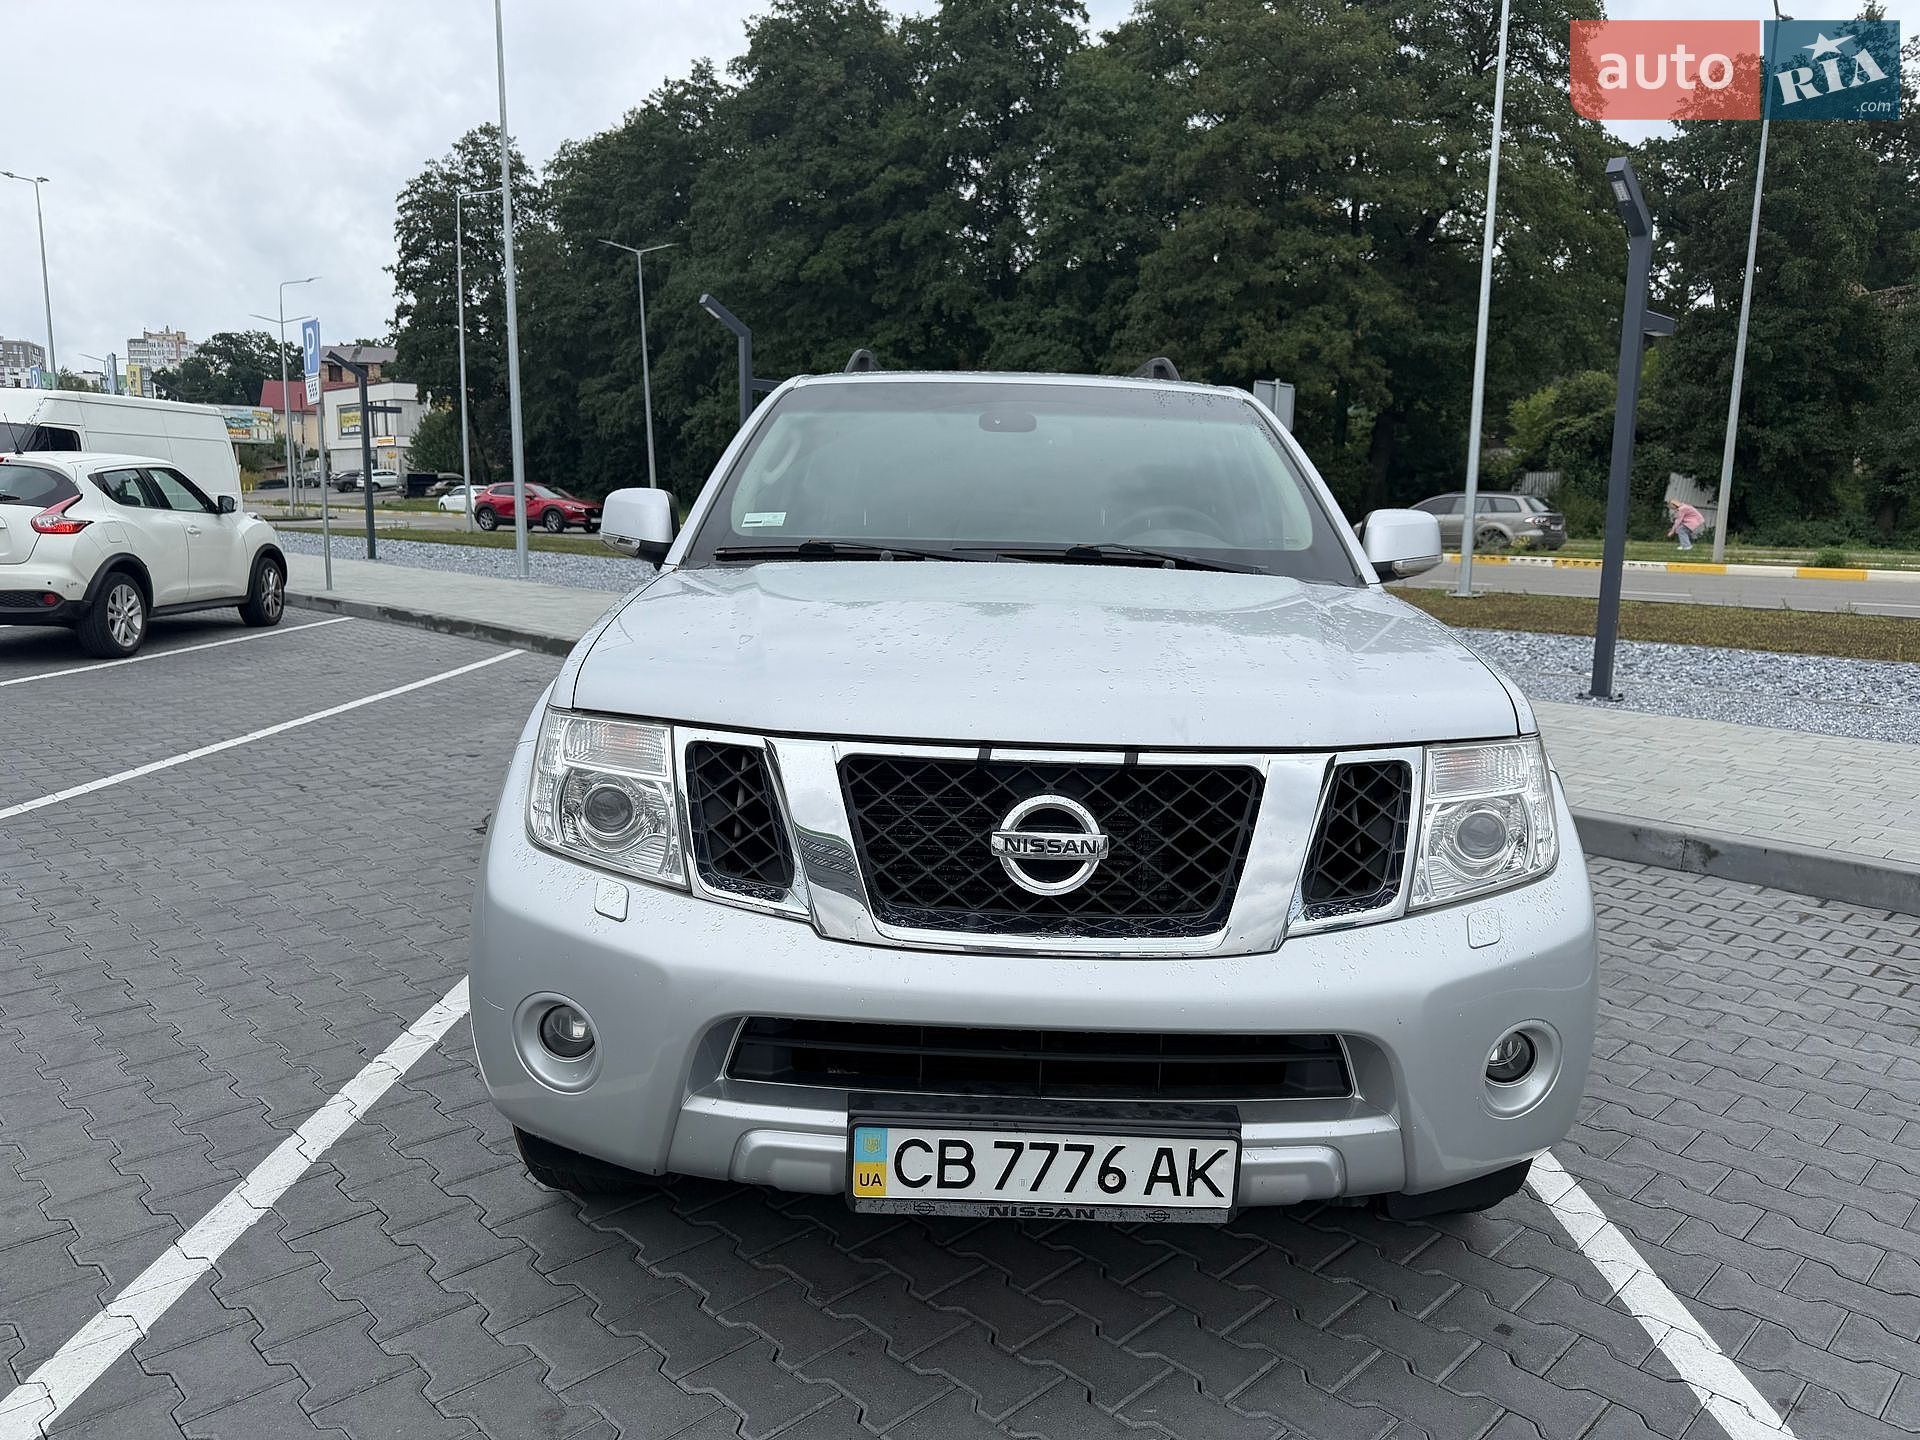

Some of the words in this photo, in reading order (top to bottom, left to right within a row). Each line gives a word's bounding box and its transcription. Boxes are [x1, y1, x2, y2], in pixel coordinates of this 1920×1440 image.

[305, 327, 315, 370] P
[1004, 838, 1097, 854] NISSAN
[894, 1138, 976, 1188] CB
[993, 1141, 1127, 1194] 7776
[1143, 1147, 1229, 1197] AK
[859, 1173, 883, 1187] UA
[987, 1206, 1096, 1219] NISSAN
